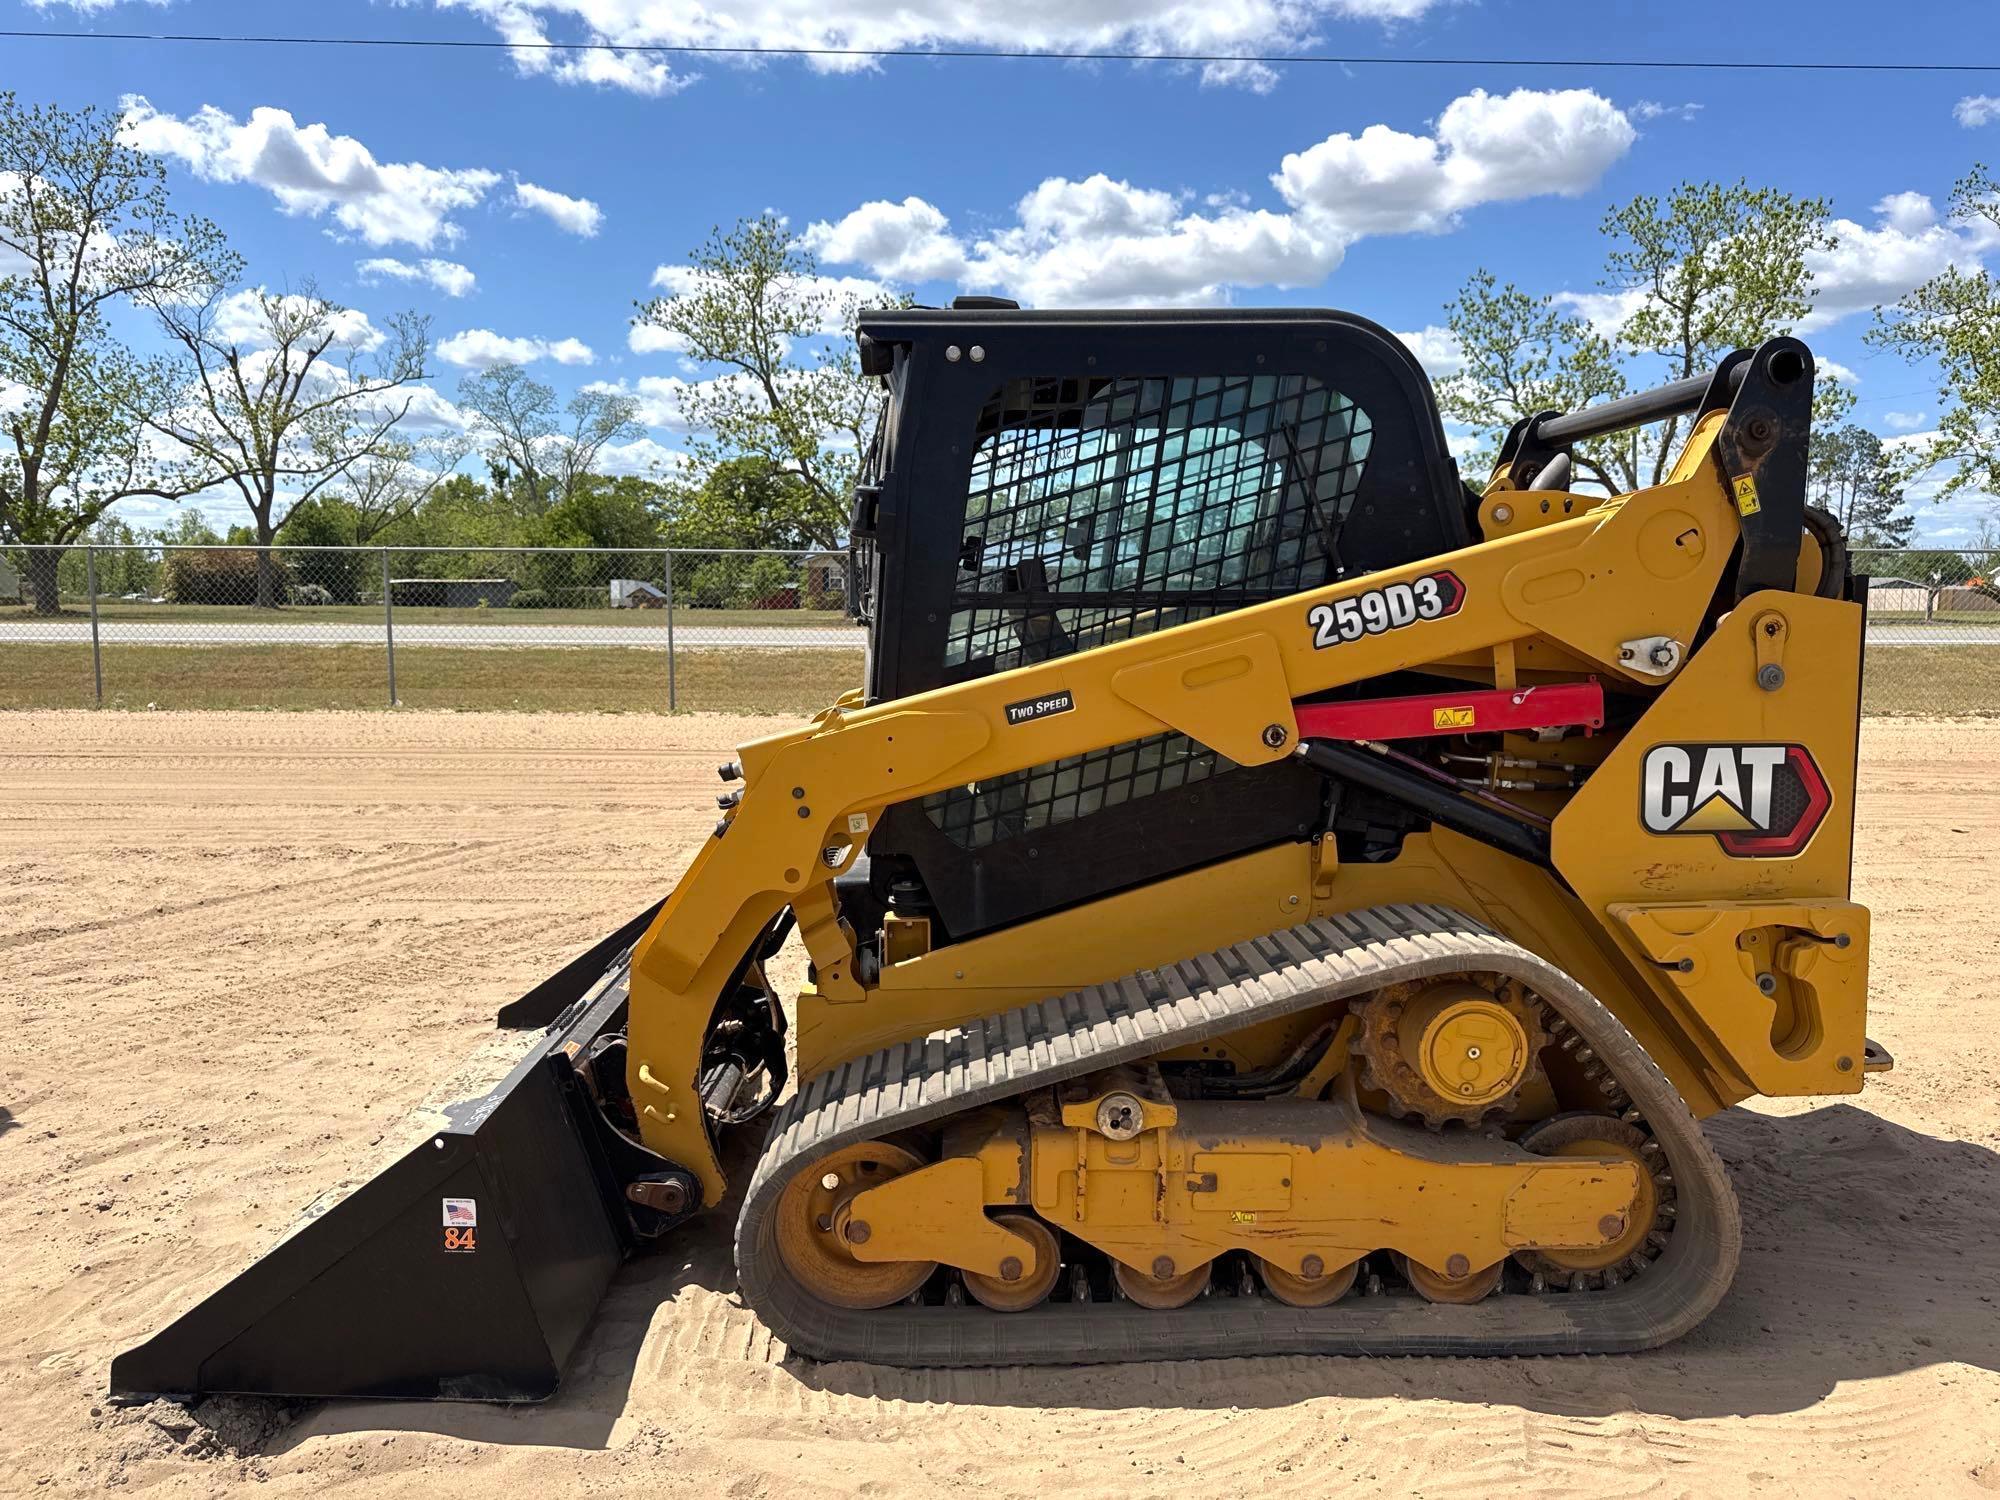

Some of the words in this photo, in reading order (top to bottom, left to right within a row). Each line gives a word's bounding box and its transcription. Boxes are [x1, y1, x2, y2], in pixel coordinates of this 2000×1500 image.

[1309, 577, 1443, 648] 259D3
[1009, 707, 1034, 720] TWO
[1036, 697, 1068, 714] SPEED
[1645, 746, 1786, 831] CAT
[444, 1227, 476, 1250] 84
